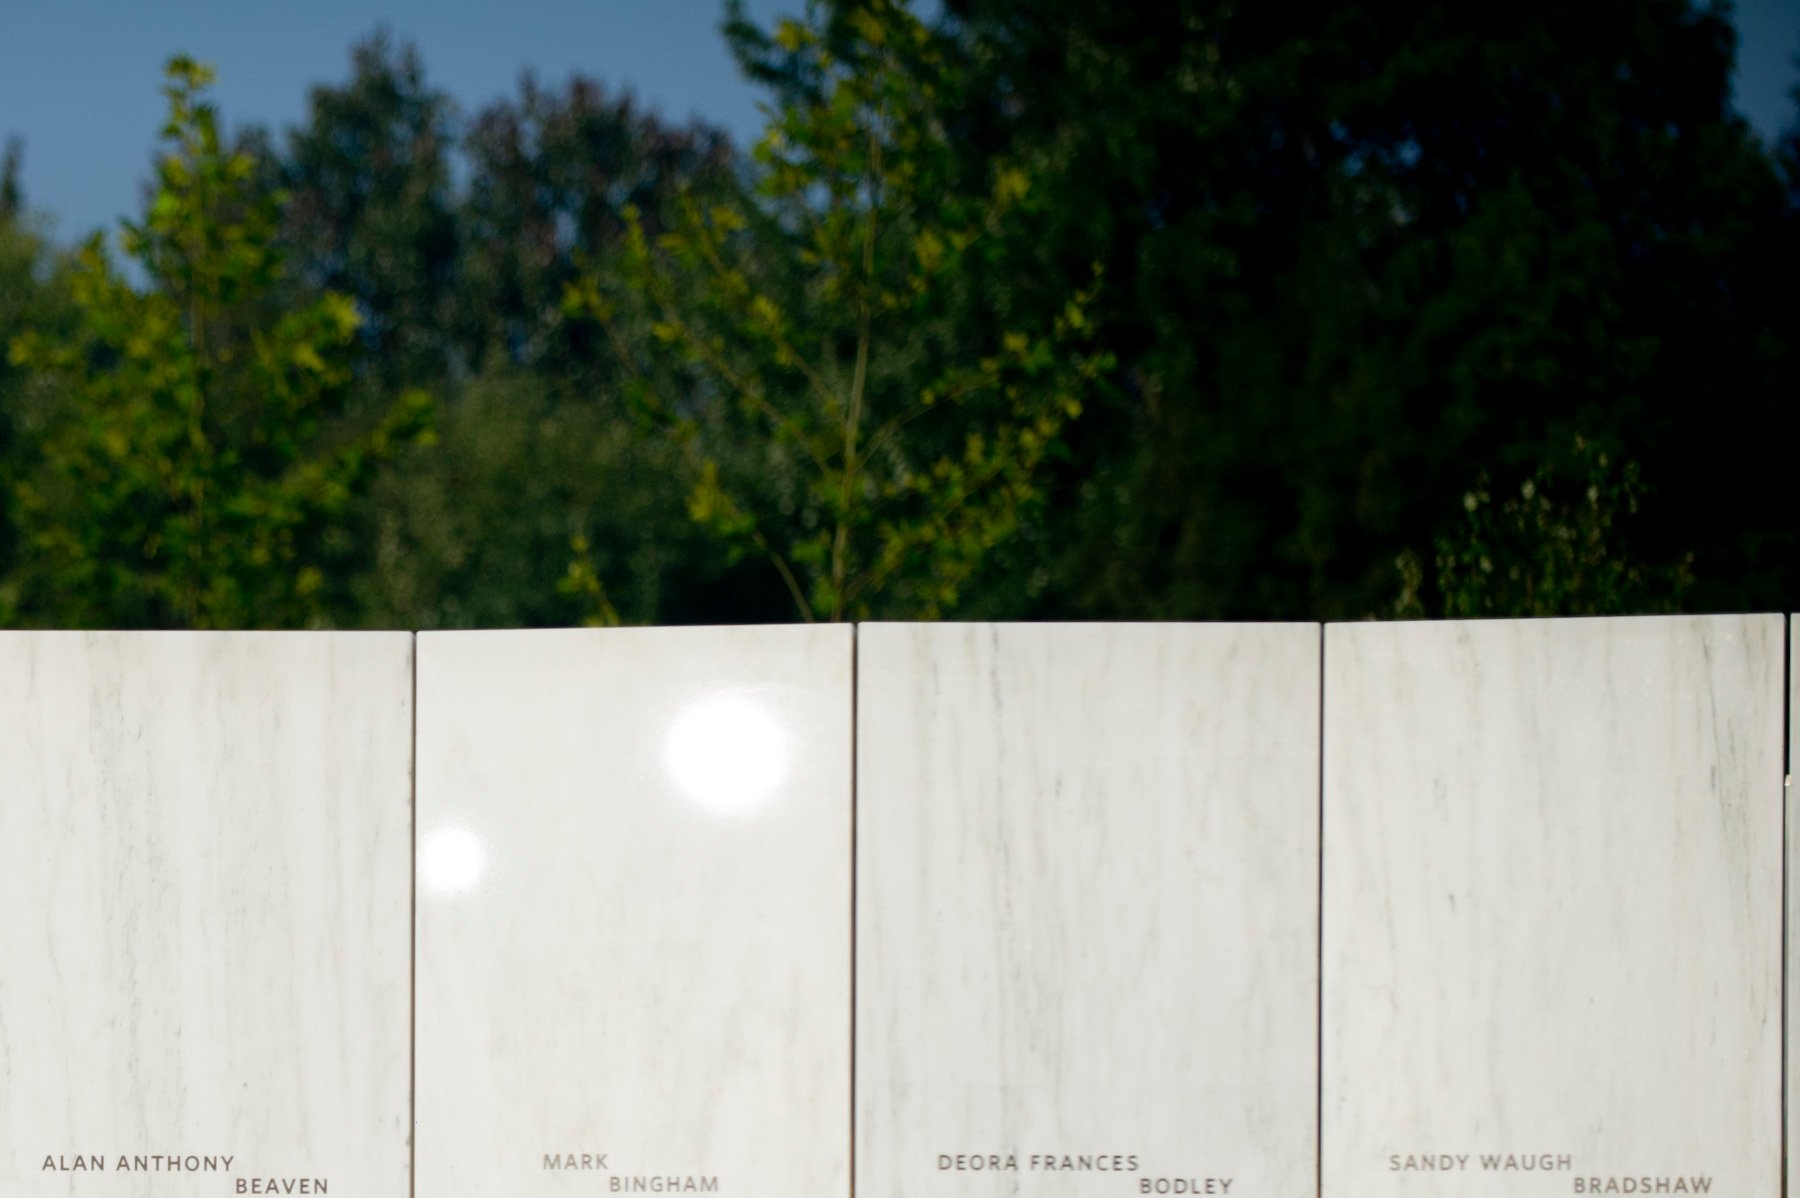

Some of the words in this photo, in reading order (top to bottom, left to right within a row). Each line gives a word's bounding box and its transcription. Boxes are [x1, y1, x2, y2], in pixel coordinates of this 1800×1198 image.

[41, 1154, 105, 1172] ALAN
[115, 1154, 235, 1172] ANTHONY
[543, 1153, 609, 1171] MARK
[938, 1154, 1019, 1172] DEORA
[1029, 1154, 1141, 1172] FRANCES
[1389, 1154, 1470, 1172] SANDY
[1479, 1154, 1573, 1172] WAUGH
[235, 1177, 328, 1195] BEAVEN
[609, 1175, 719, 1193] BINGHAM
[1139, 1177, 1233, 1195] BODLEY
[1573, 1176, 1713, 1194] BRADSHAW
